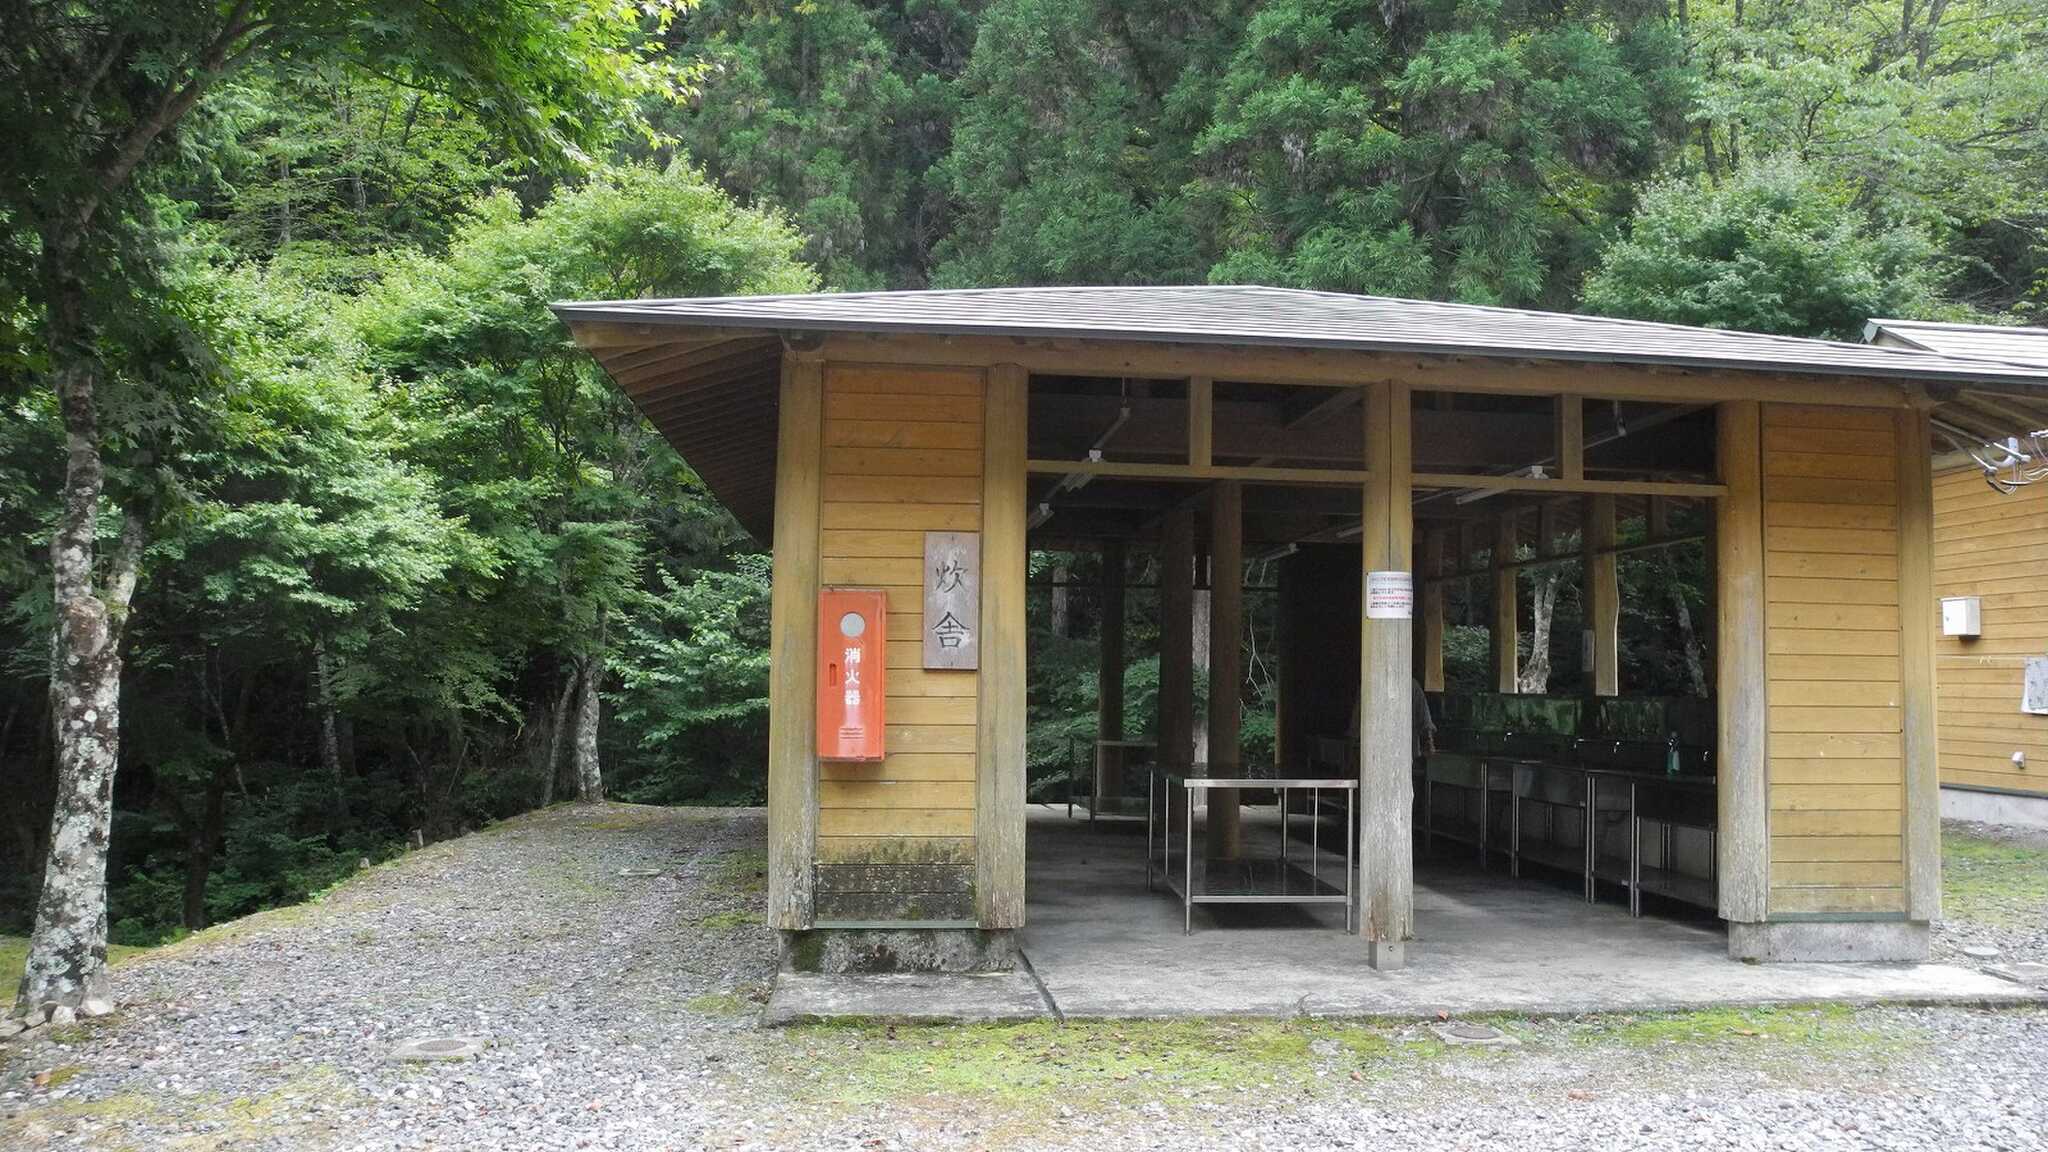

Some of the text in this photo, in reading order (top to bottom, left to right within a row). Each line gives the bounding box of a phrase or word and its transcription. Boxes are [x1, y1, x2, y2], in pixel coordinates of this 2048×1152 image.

[931, 559, 971, 649] 炊舎
[844, 648, 862, 706] 消火器
